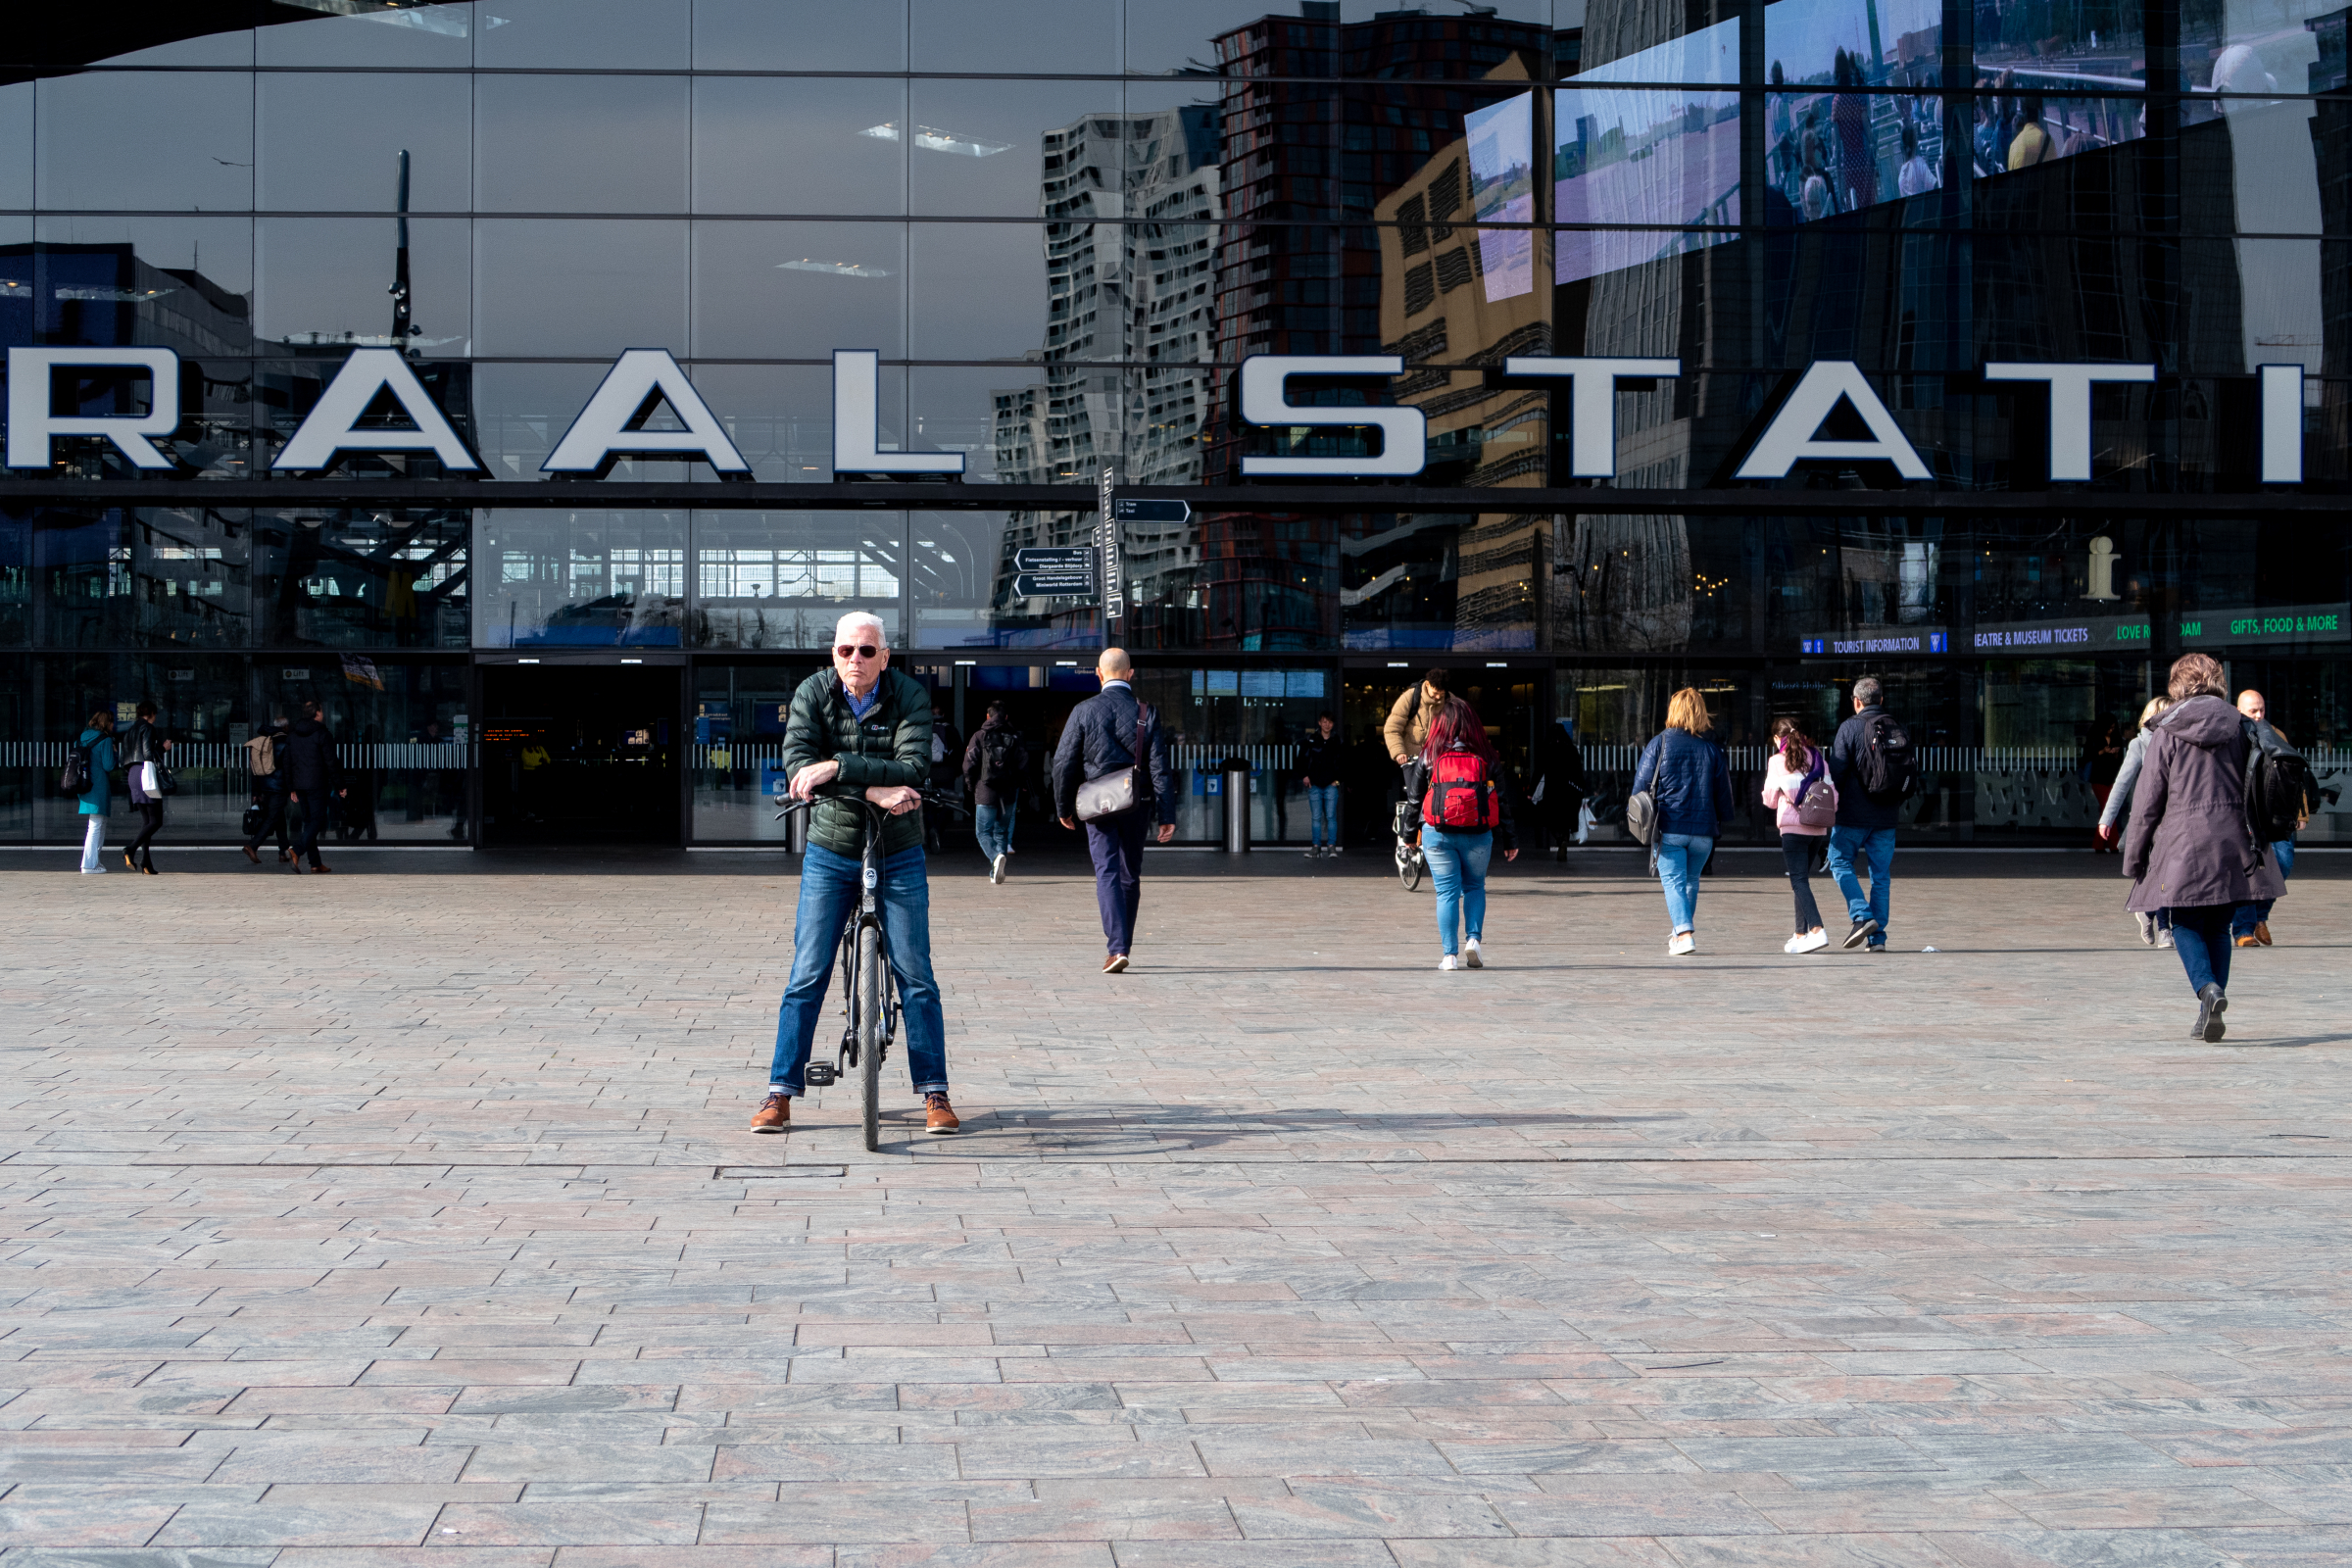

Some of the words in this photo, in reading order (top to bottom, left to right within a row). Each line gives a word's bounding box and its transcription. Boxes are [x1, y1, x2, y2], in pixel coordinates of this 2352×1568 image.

[6, 345, 966, 474] RAAL
[1240, 354, 2305, 484] STATI
[2117, 625, 2141, 640] LOVE
[2230, 619, 2261, 636] GIFTS,
[2264, 617, 2294, 633] FOOD
[2296, 617, 2304, 632] &
[2307, 614, 2338, 631] MORE
[1833, 640, 1864, 653] TOURIST
[1865, 637, 1920, 652] INFORMATION
[2005, 631, 2012, 646] &
[2013, 630, 2052, 645] MUSEUM
[2054, 628, 2088, 642] TICKETS
